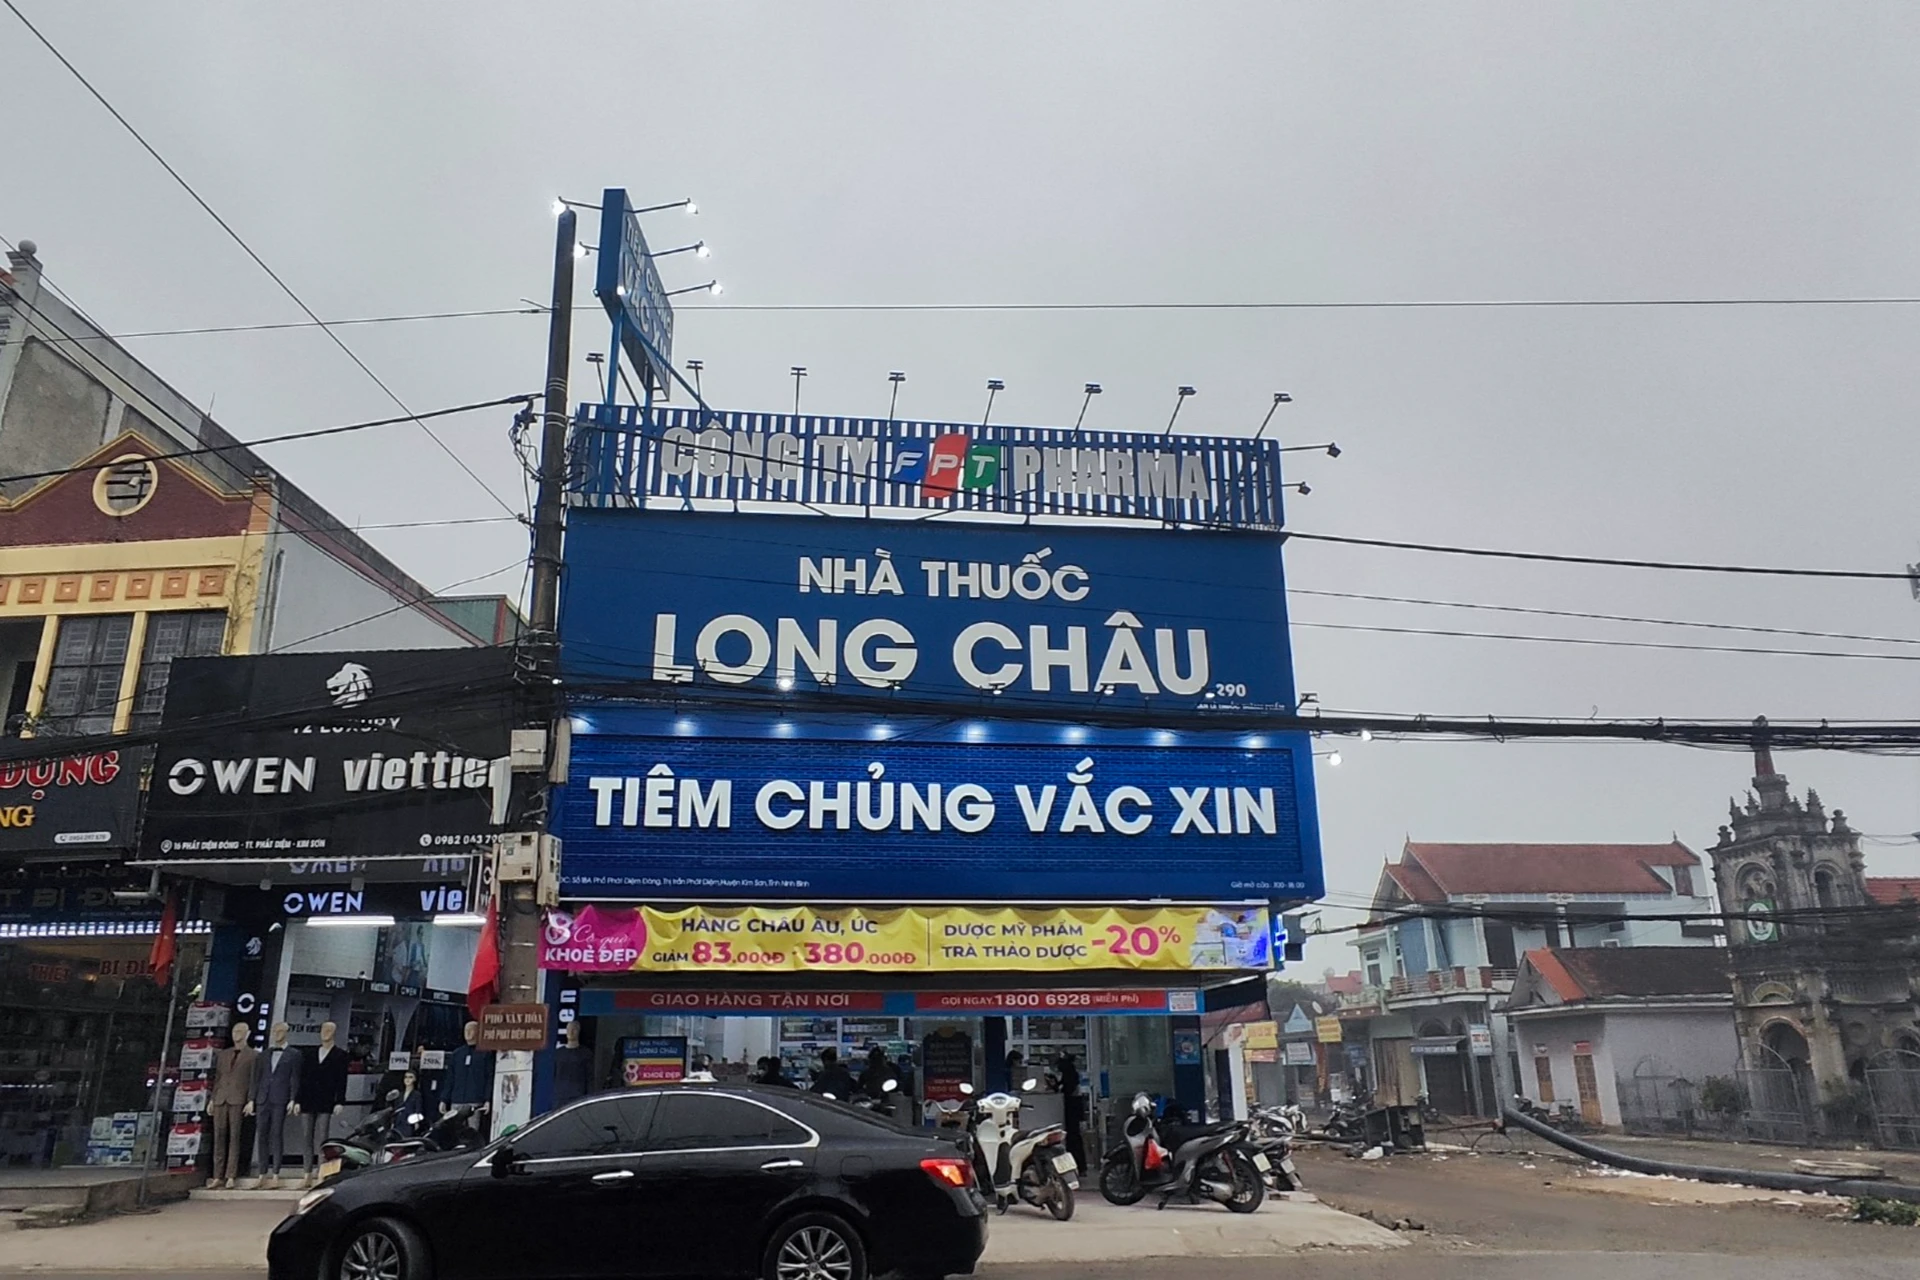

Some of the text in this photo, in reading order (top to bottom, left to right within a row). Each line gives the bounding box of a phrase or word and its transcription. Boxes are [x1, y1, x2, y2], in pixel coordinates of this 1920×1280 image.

[660, 420, 799, 481] CÔNG
[816, 435, 876, 483] TY
[1013, 445, 1209, 500] PHARMA
[799, 546, 1091, 602] NHÀ THUỐC
[652, 610, 1211, 697] LONG CHÂU
[1215, 683, 1247, 698] 290
[168, 756, 317, 796] OWEN
[588, 756, 1278, 835] TIÊM CHỦNG VẮC XIN
[283, 891, 364, 914] OWEN
[681, 915, 879, 936] HÀNG CHÂU ÂU, ÚC
[944, 919, 1084, 940] DƯỢC MỸ PHẨM
[941, 941, 1088, 960] TRÀ THẢO DƯỢC
[1091, 924, 1182, 957] -20%
[598, 947, 638, 966] ĐẸP
[652, 948, 689, 963] GIẢM
[650, 991, 850, 1010] GIAO HÀNG TẬN NƠI
[940, 996, 961, 1007] GỌI
[995, 993, 1040, 1006] 1800
[1045, 993, 1091, 1006] 6928
